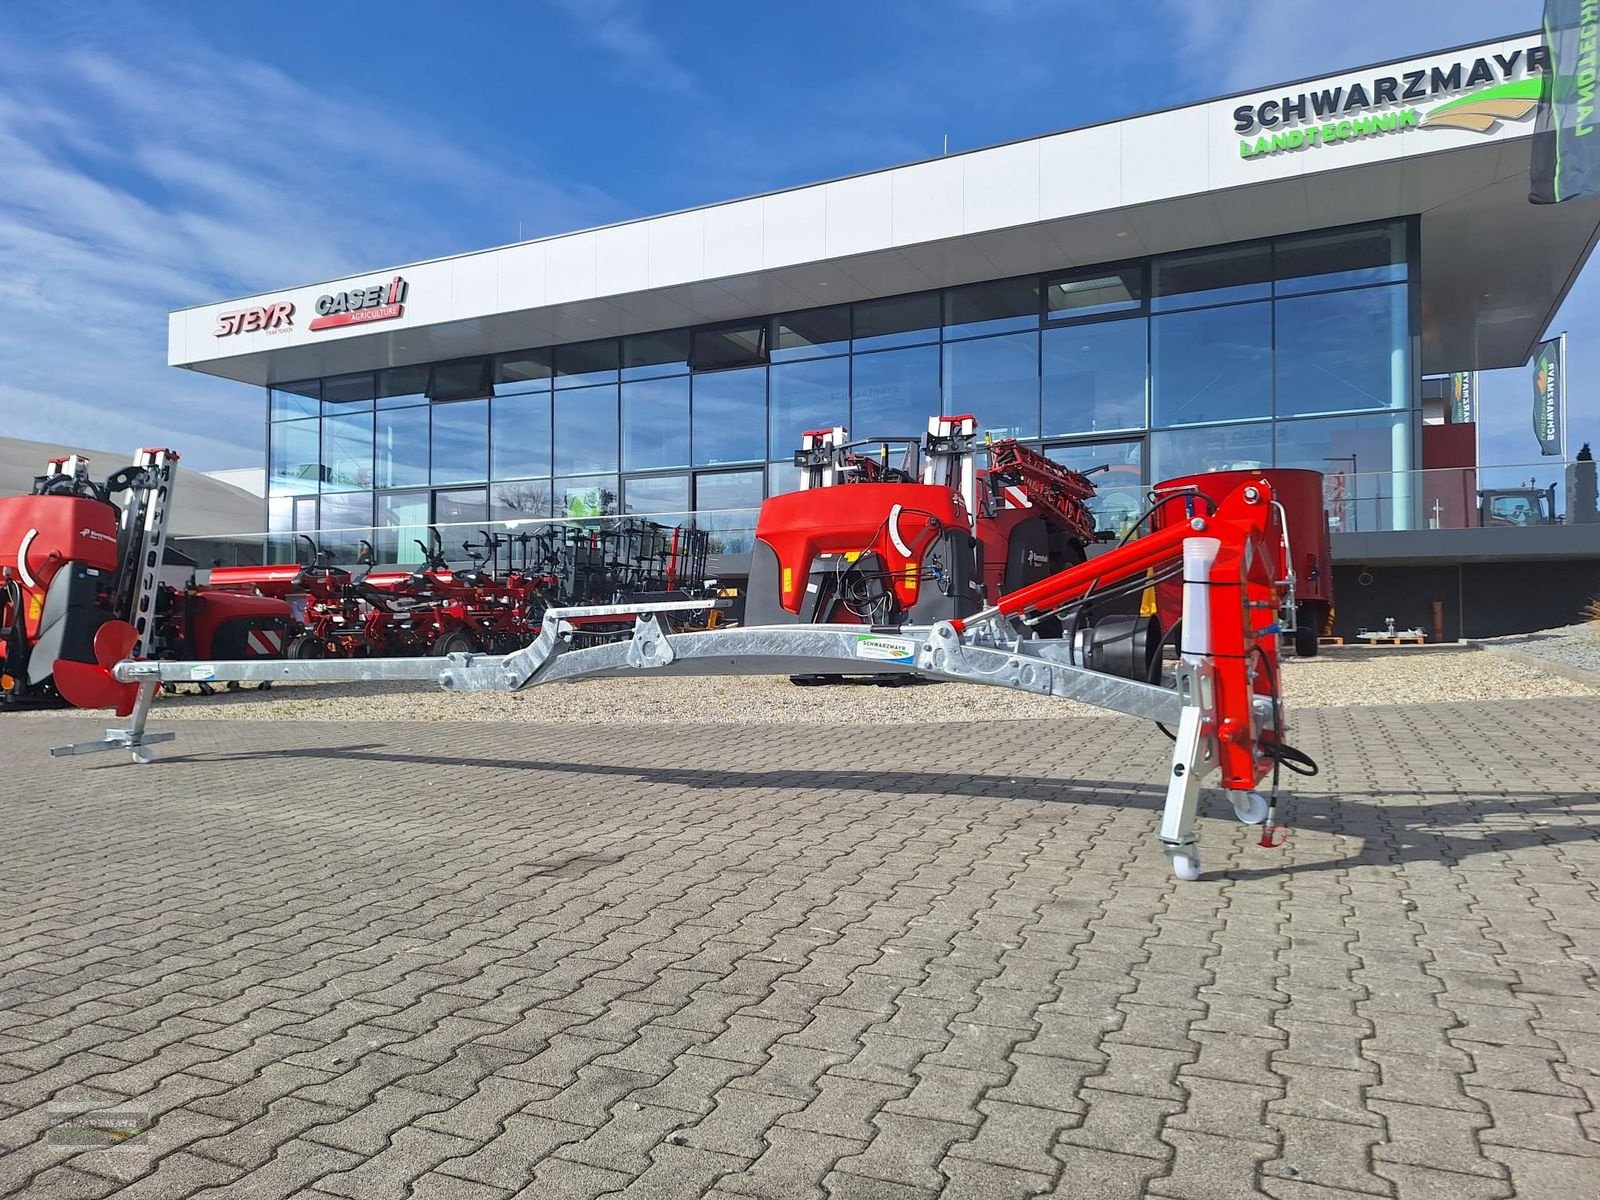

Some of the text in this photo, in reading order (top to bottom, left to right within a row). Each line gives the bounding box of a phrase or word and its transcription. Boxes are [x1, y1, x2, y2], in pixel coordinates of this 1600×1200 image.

[1233, 46, 1552, 132] SCHWARZMAYR
[1239, 108, 1417, 157] LANDTECHNIK
[315, 285, 382, 316] CASE
[351, 308, 397, 321] AGRICULTURE
[213, 302, 295, 337] STEYR
[863, 640, 906, 650] SCHWARZMAYR
